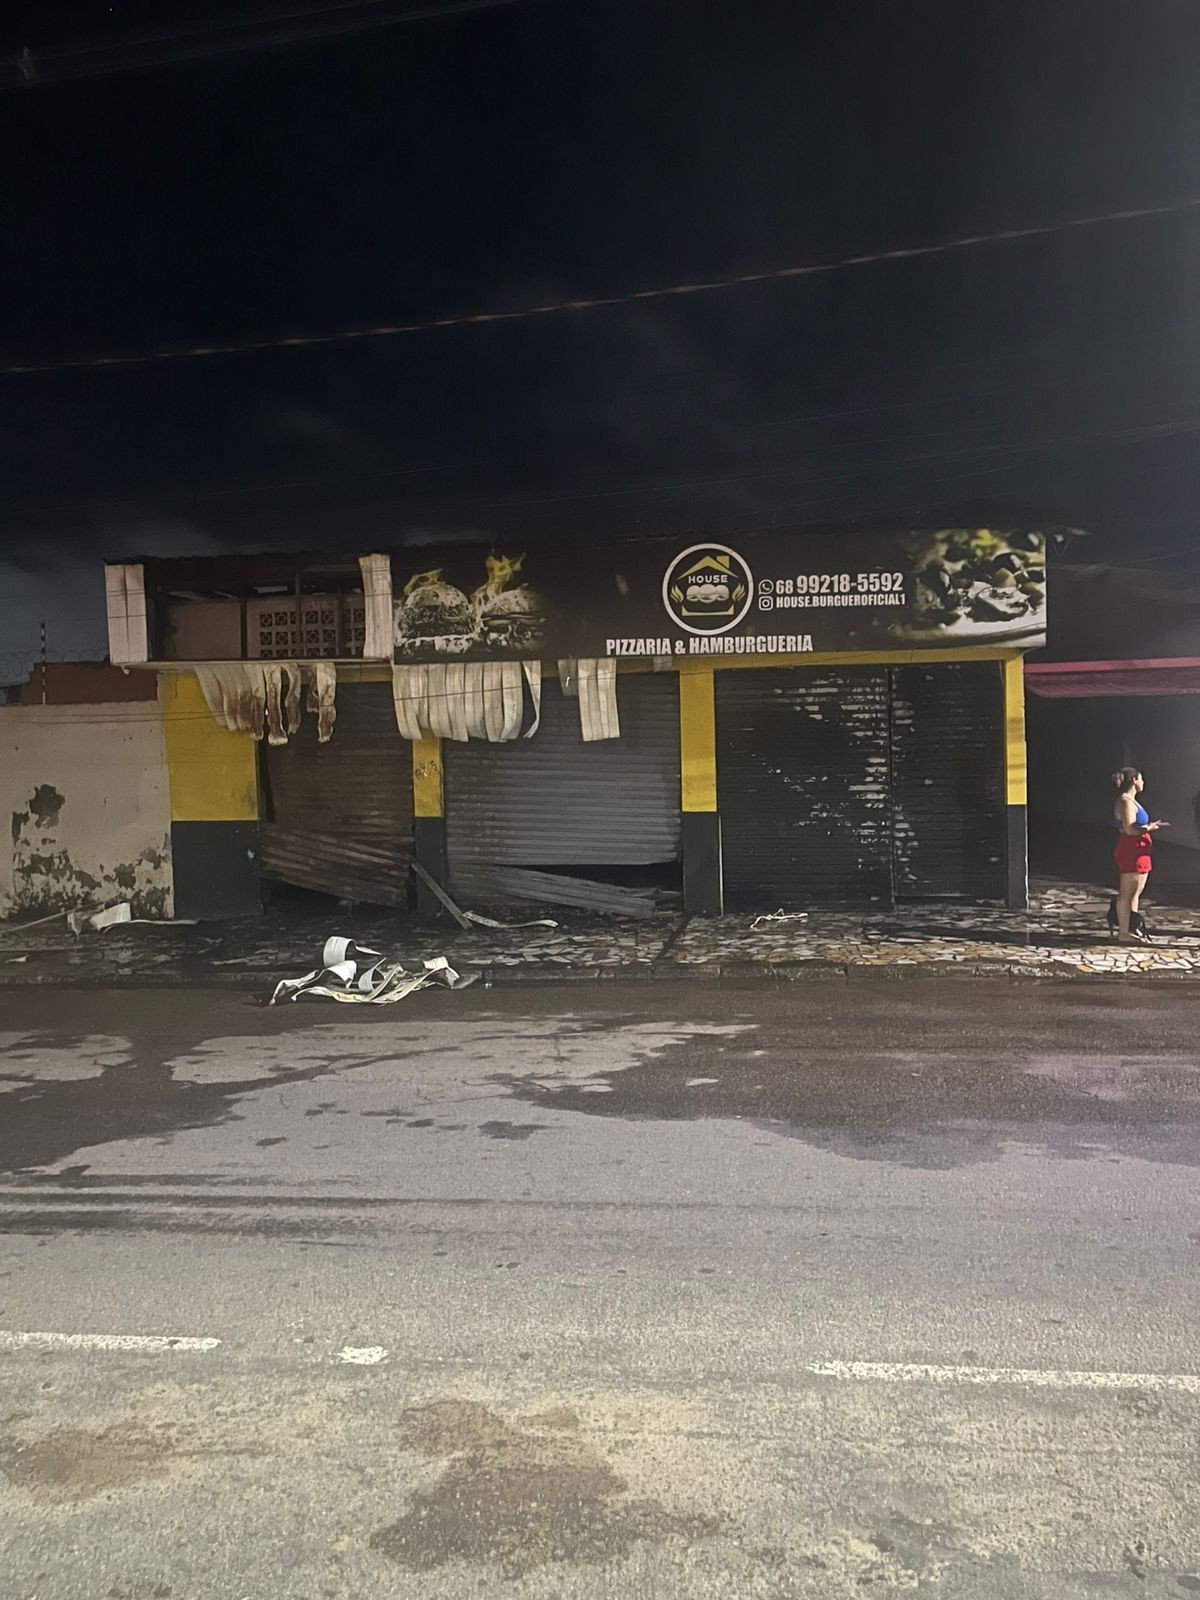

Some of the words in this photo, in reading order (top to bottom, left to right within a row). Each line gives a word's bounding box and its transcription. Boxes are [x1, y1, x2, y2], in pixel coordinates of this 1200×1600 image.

[688, 575, 729, 584] HOUSE
[775, 579, 794, 595] 68
[796, 572, 904, 594] 99218-5592
[606, 638, 672, 655] PIZZARIA
[674, 640, 686, 655] &
[689, 635, 814, 654] HAMBURGUERIA
